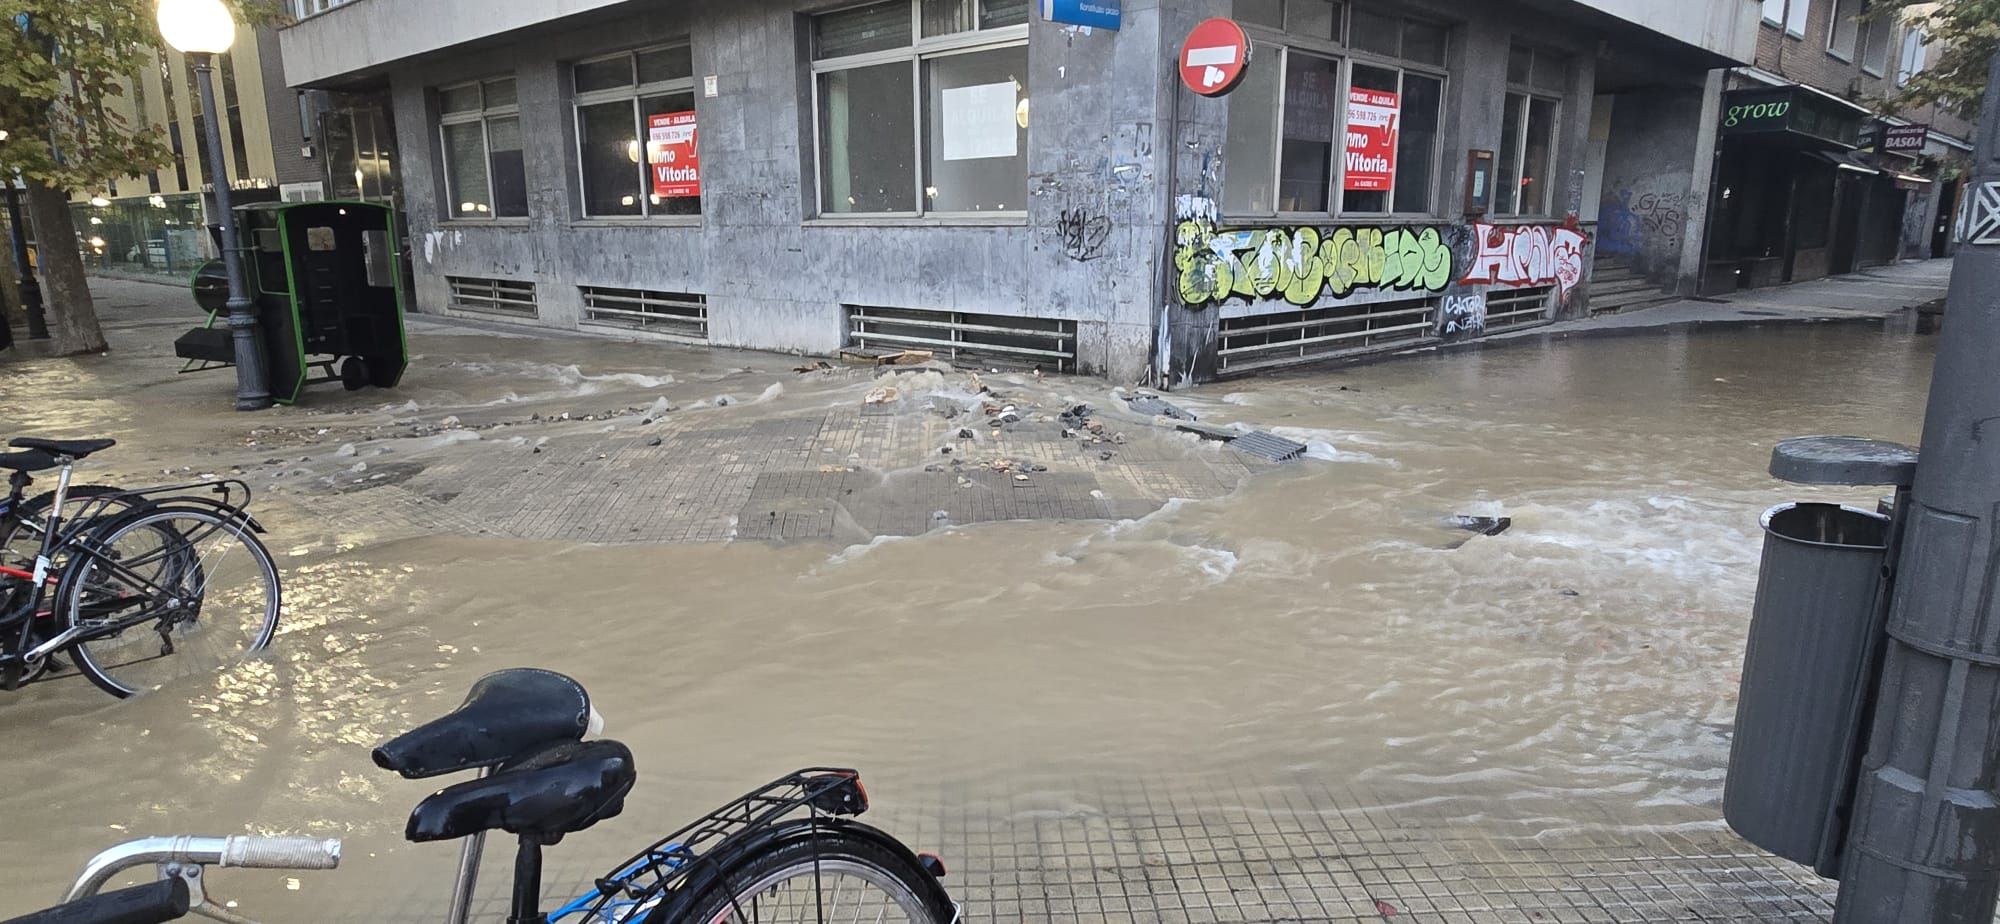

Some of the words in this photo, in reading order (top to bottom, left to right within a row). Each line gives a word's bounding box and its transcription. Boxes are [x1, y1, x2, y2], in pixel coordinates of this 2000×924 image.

[1371, 95, 1396, 107] ALQUILA
[1724, 101, 1790, 127] grow
[1346, 132, 1369, 149] nmo
[1885, 136, 1923, 148] BASOA
[1346, 151, 1388, 173] Vitoria
[657, 164, 697, 182] Vitoria
